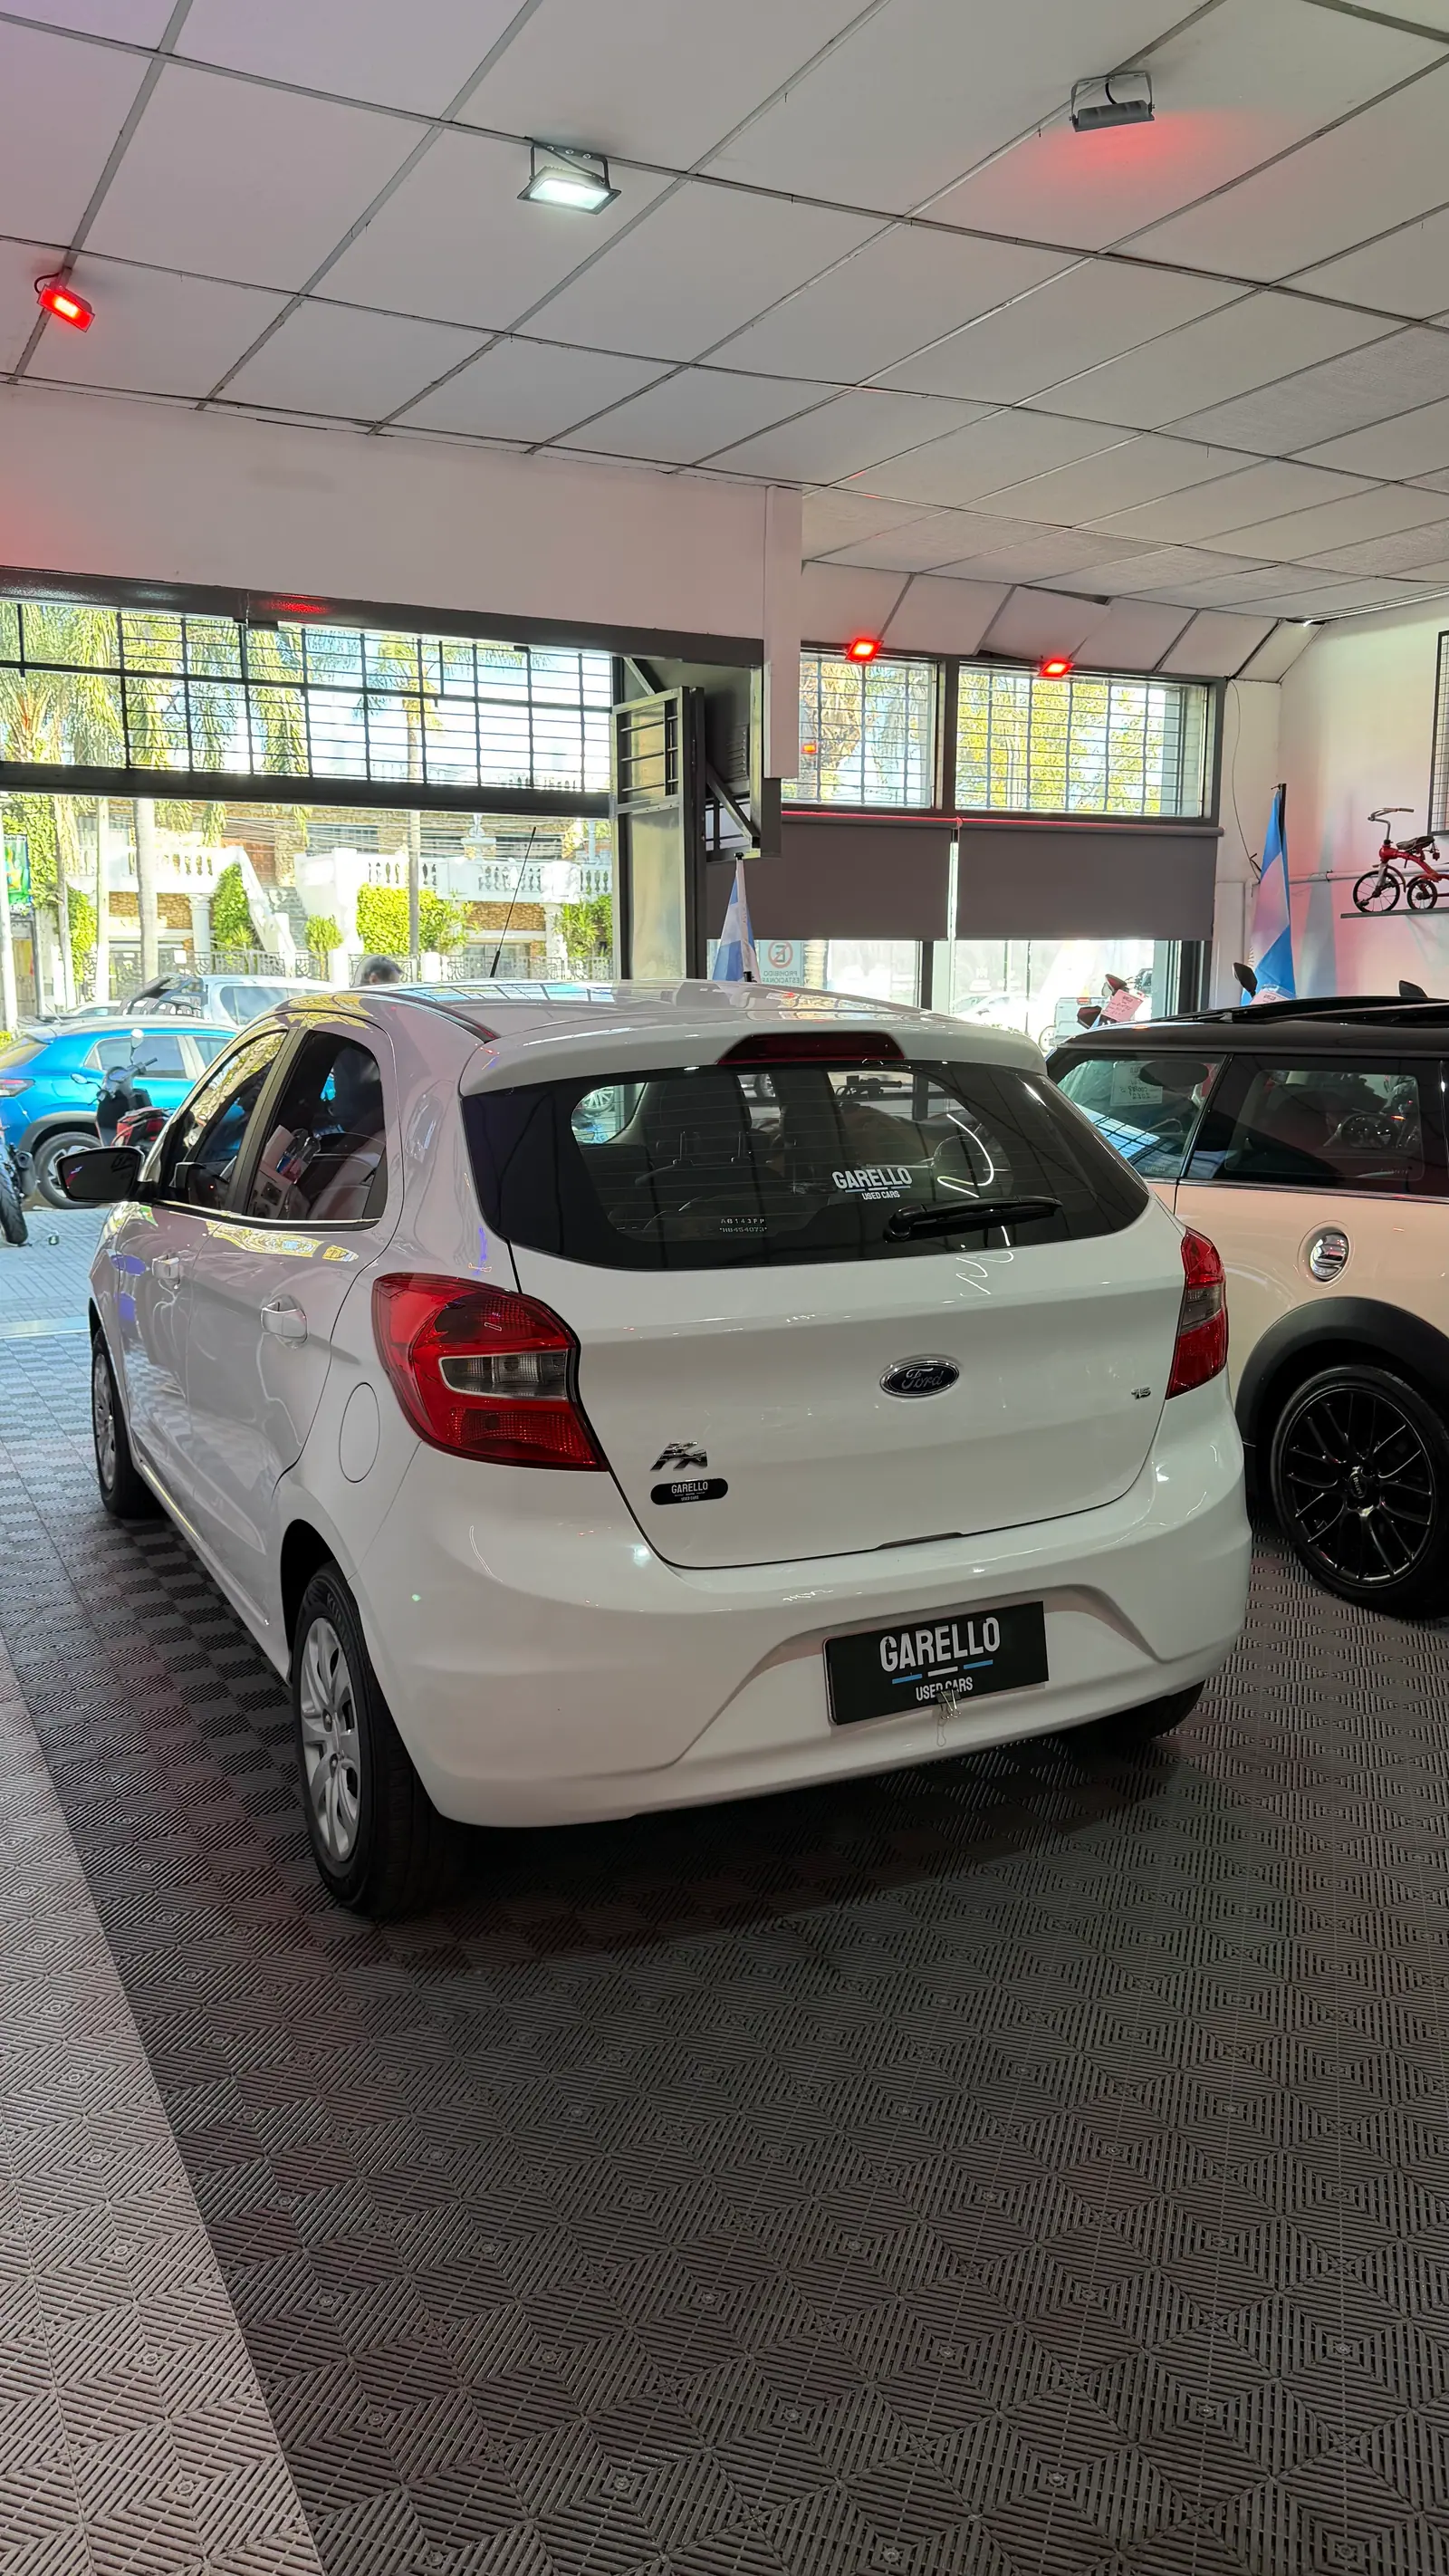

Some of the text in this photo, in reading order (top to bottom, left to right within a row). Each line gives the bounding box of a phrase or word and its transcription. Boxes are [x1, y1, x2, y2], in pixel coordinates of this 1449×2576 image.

[831, 1167, 913, 1189] GARELLO
[861, 1190, 901, 1200] USED CARS
[901, 1367, 945, 1389] Ford
[671, 1481, 708, 1495] GARELLO
[879, 1617, 1001, 1672] GARELLO
